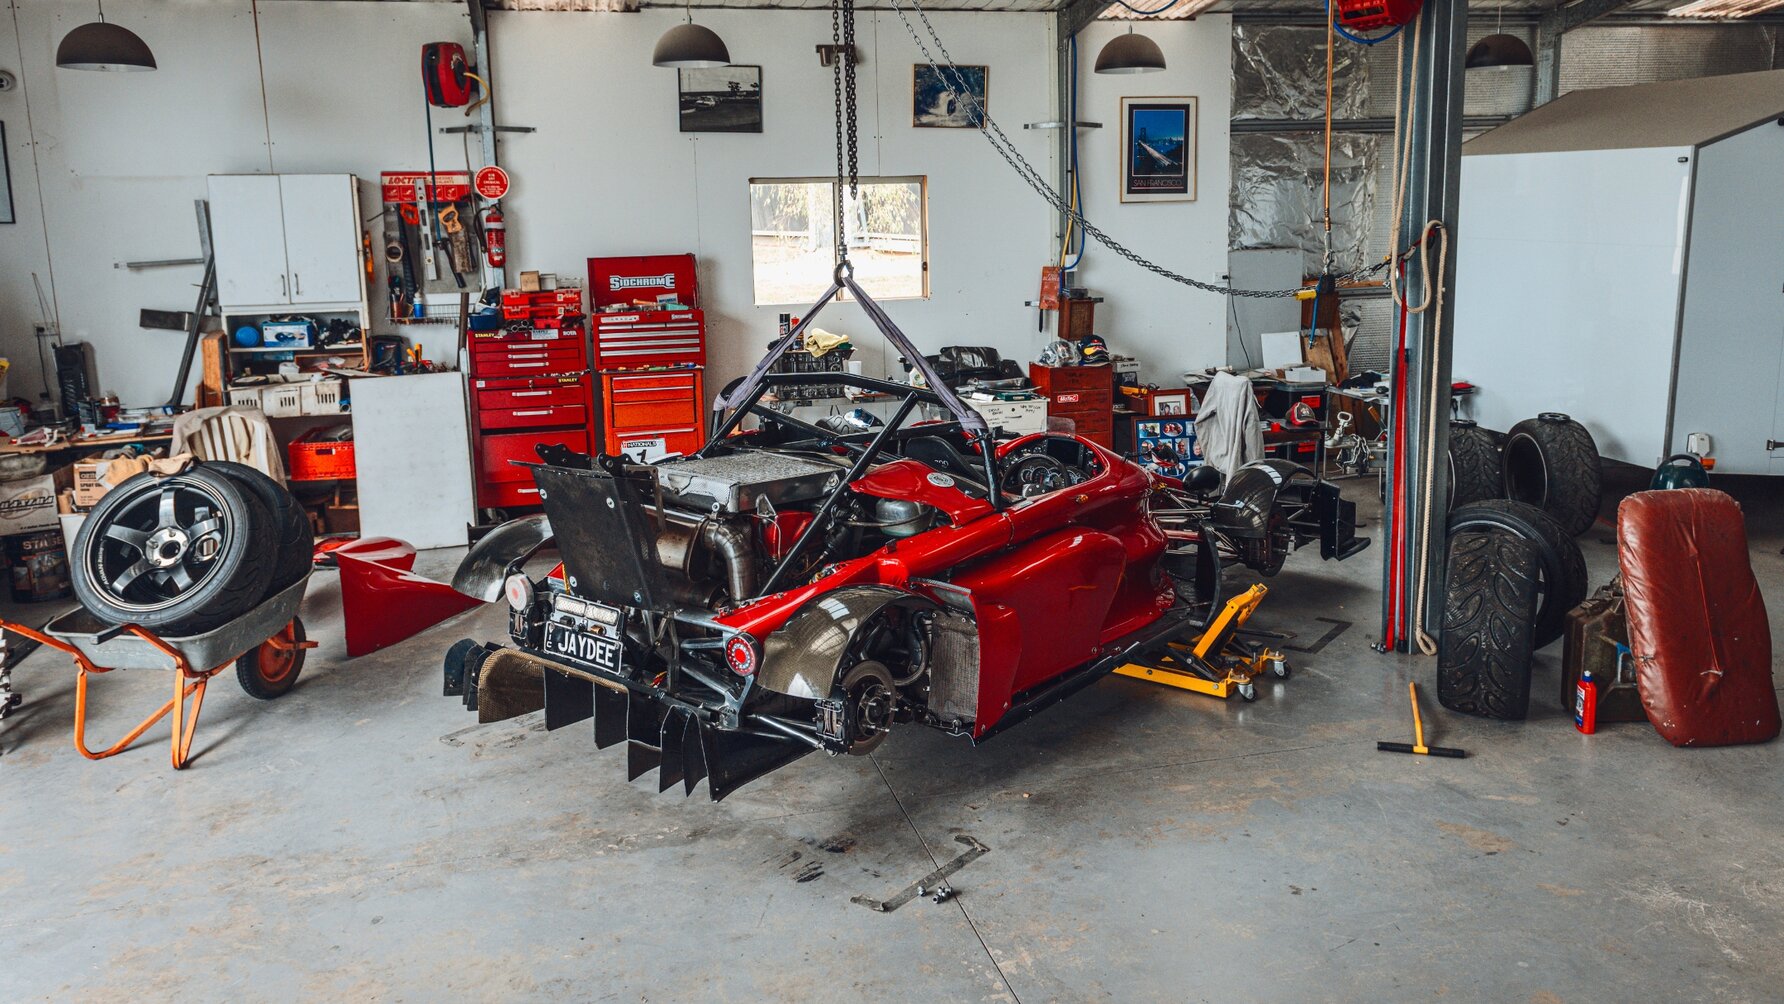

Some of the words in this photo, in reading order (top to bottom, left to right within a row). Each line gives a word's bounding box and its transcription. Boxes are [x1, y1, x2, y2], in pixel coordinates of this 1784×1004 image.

[1133, 179, 1147, 187] SAN
[1147, 179, 1182, 187] FRANCISCO
[609, 273, 675, 291] SIDCHROME
[547, 622, 555, 648] VIC
[558, 631, 616, 667] JAYDEE
